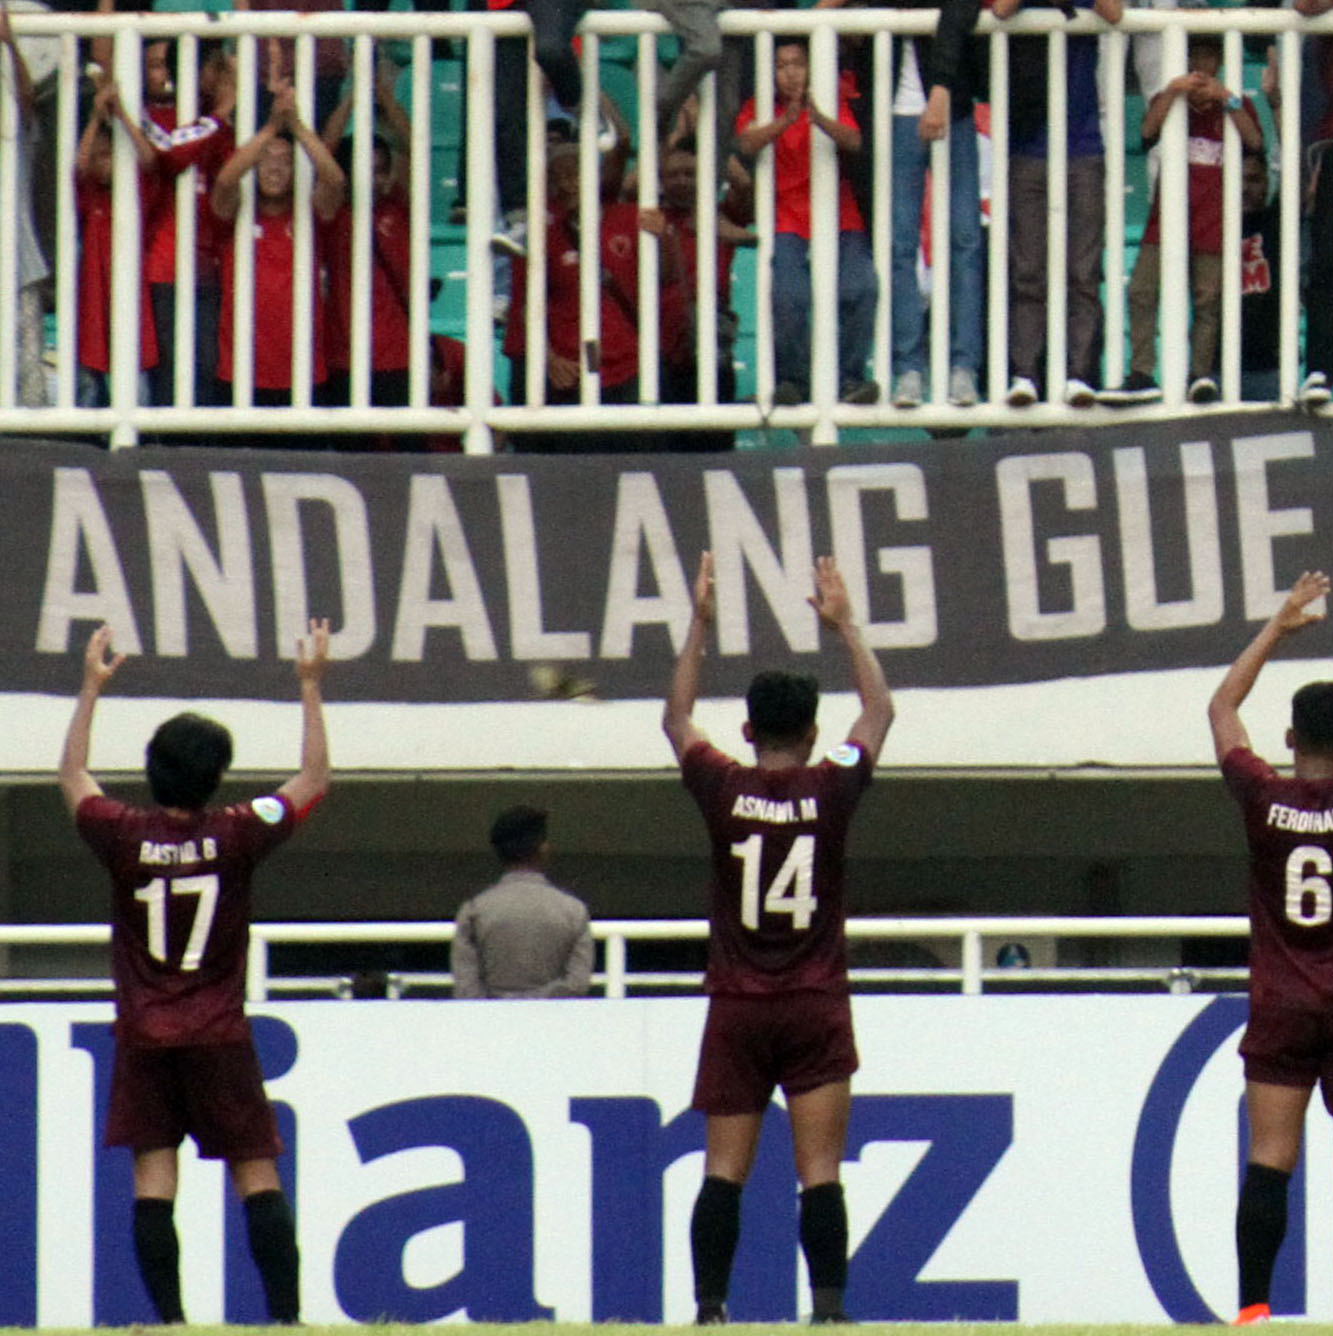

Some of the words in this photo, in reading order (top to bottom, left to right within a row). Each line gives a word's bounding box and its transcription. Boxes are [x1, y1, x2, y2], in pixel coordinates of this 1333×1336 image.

[36, 462, 940, 662] ANDALANG
[799, 797, 818, 821] M
[134, 874, 220, 971] 17
[730, 833, 818, 930] 14
[1285, 845, 1333, 927] 6
